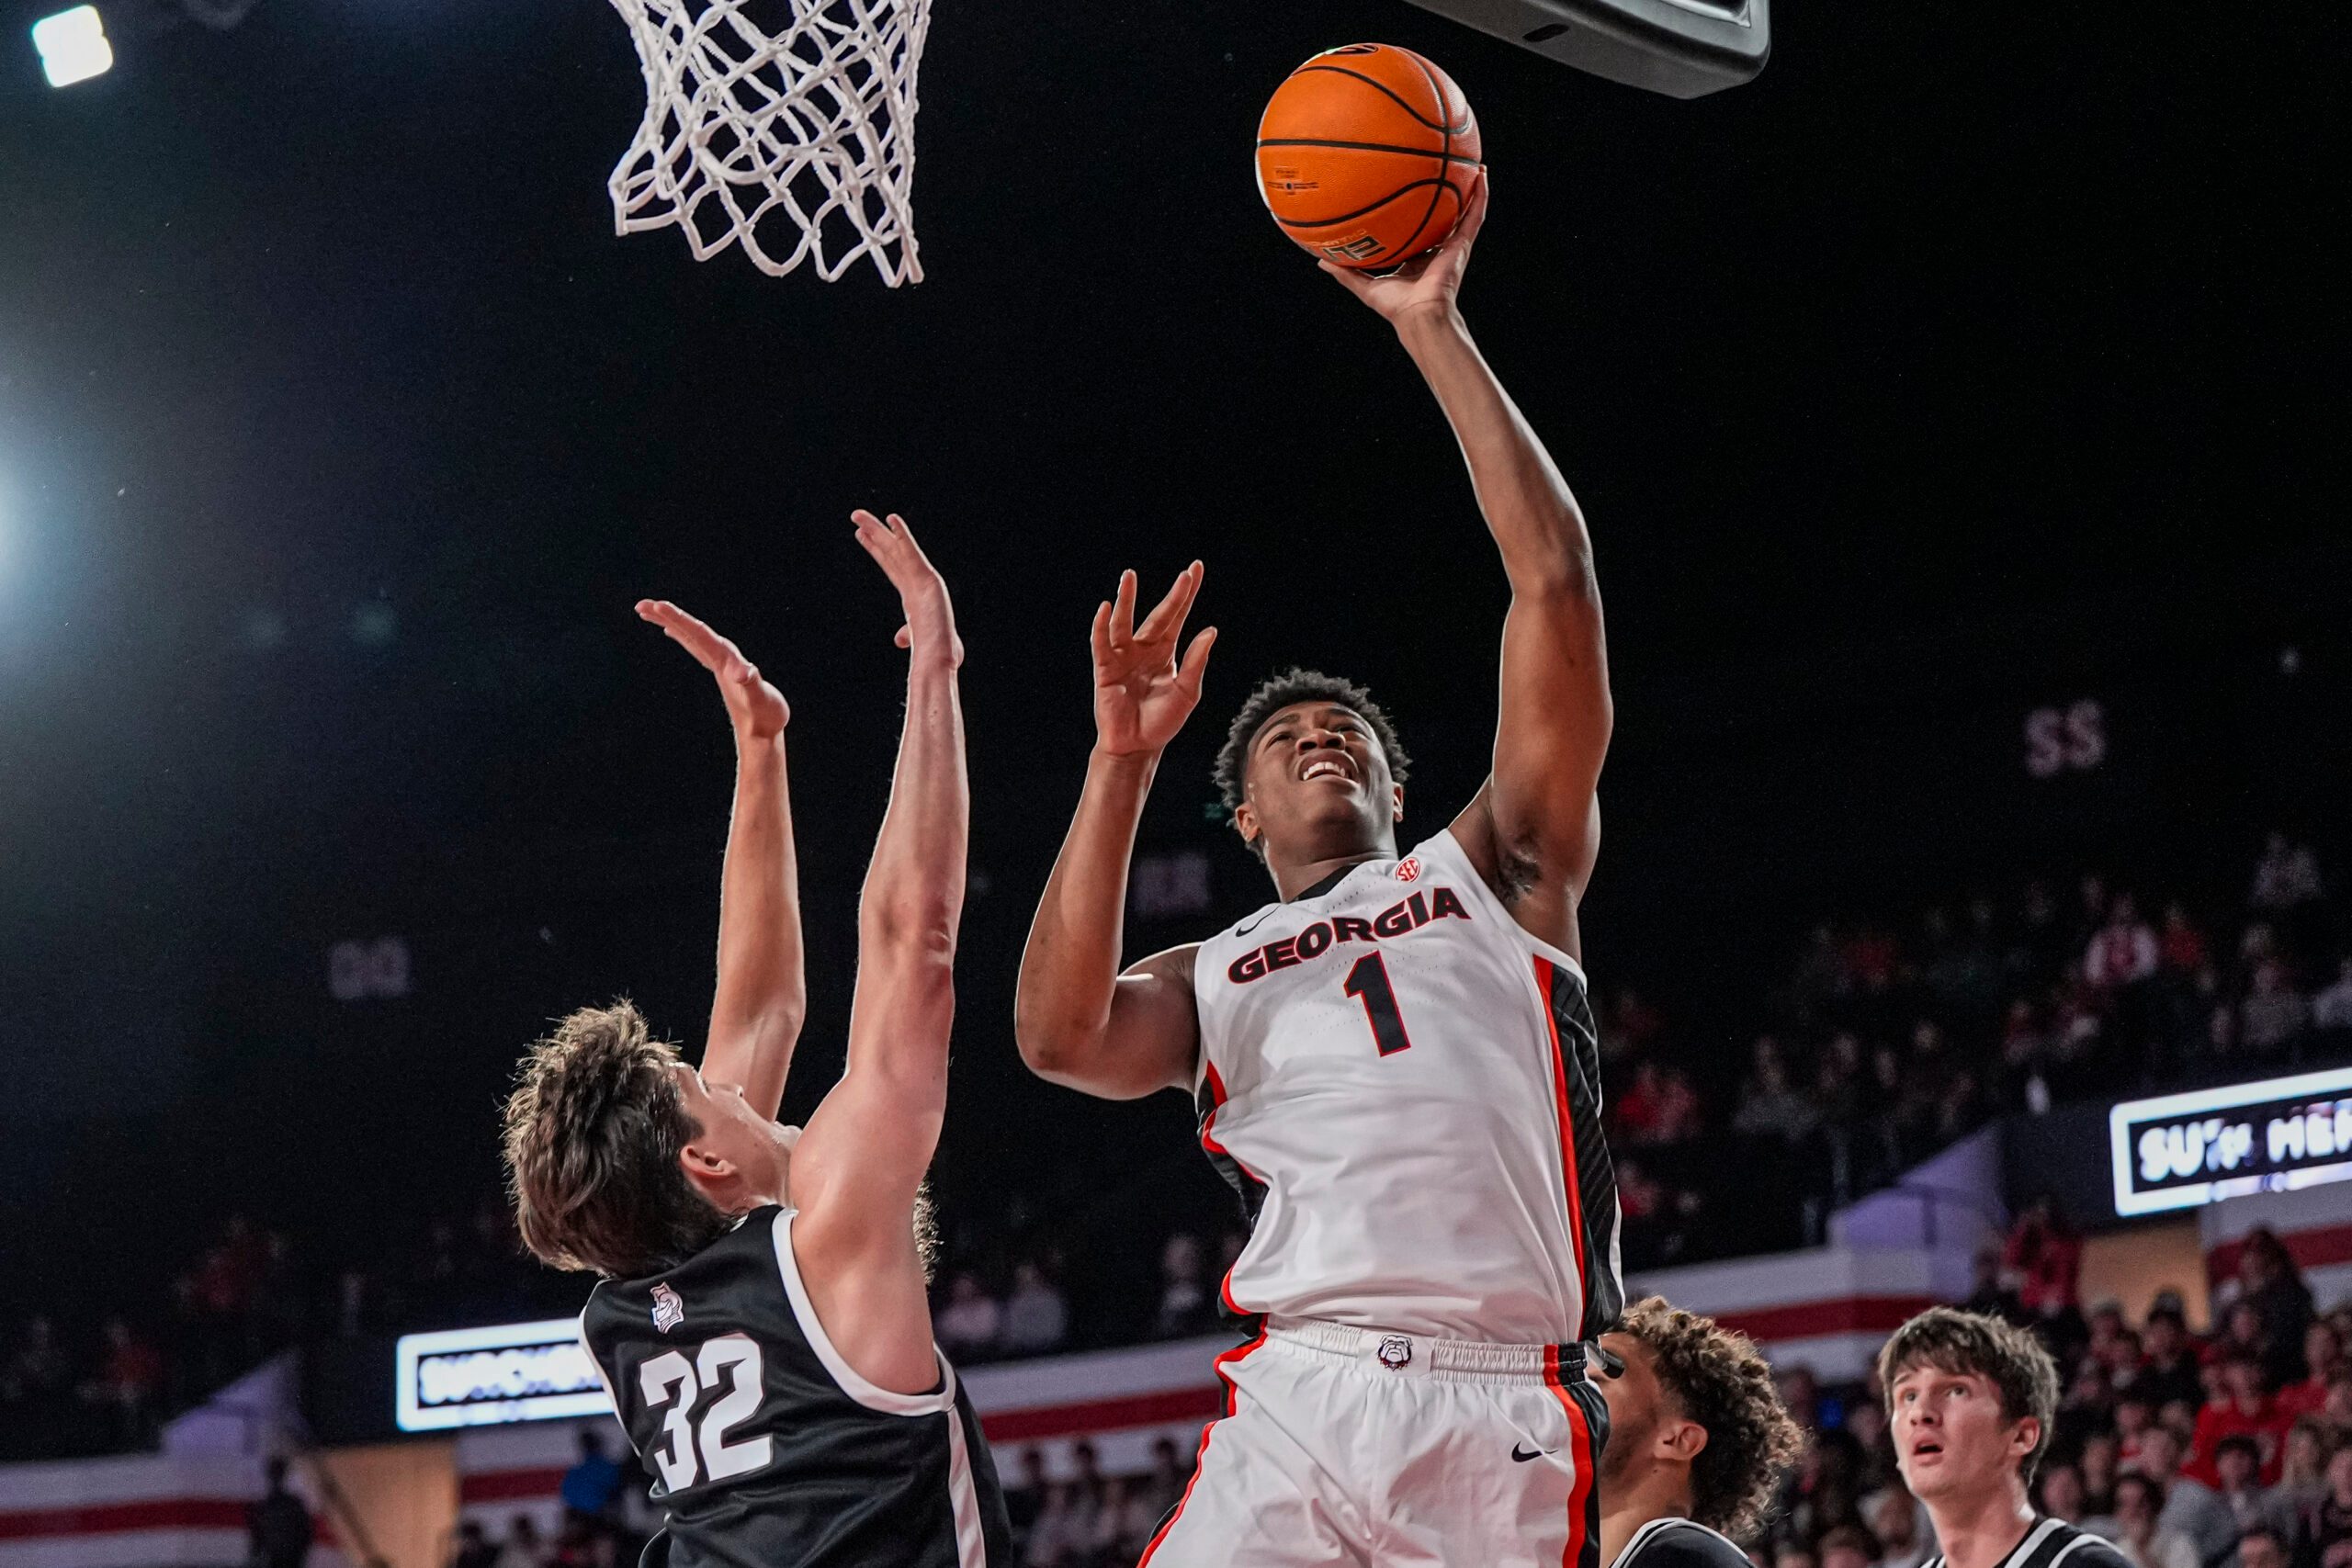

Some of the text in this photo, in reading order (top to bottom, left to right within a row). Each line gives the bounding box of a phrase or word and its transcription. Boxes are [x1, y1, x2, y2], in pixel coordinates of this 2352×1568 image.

[1397, 859, 1419, 881] SEC
[1227, 887, 1472, 984] GEORGIA
[1343, 949, 1411, 1057] 1
[639, 1333, 774, 1494] 32
